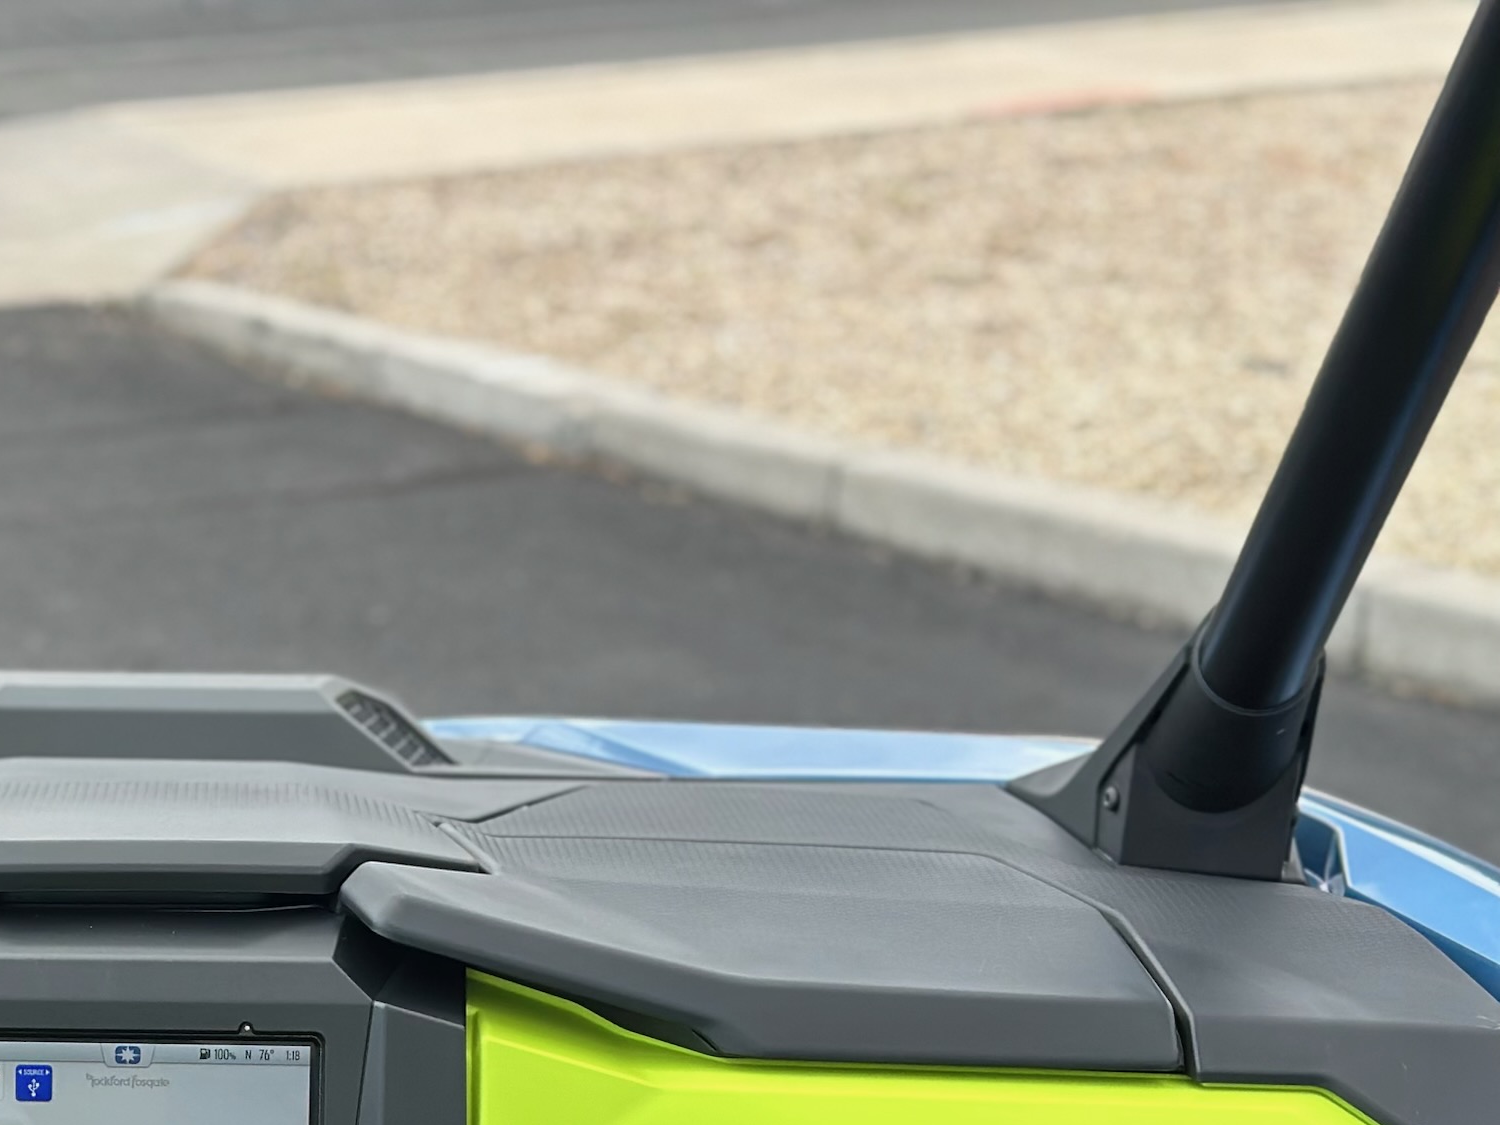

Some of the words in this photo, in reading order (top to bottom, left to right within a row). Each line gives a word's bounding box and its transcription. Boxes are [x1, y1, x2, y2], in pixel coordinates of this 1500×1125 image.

[214, 1048, 236, 1061] 100%
[245, 1050, 252, 1060] N
[286, 1050, 300, 1061] 1:18
